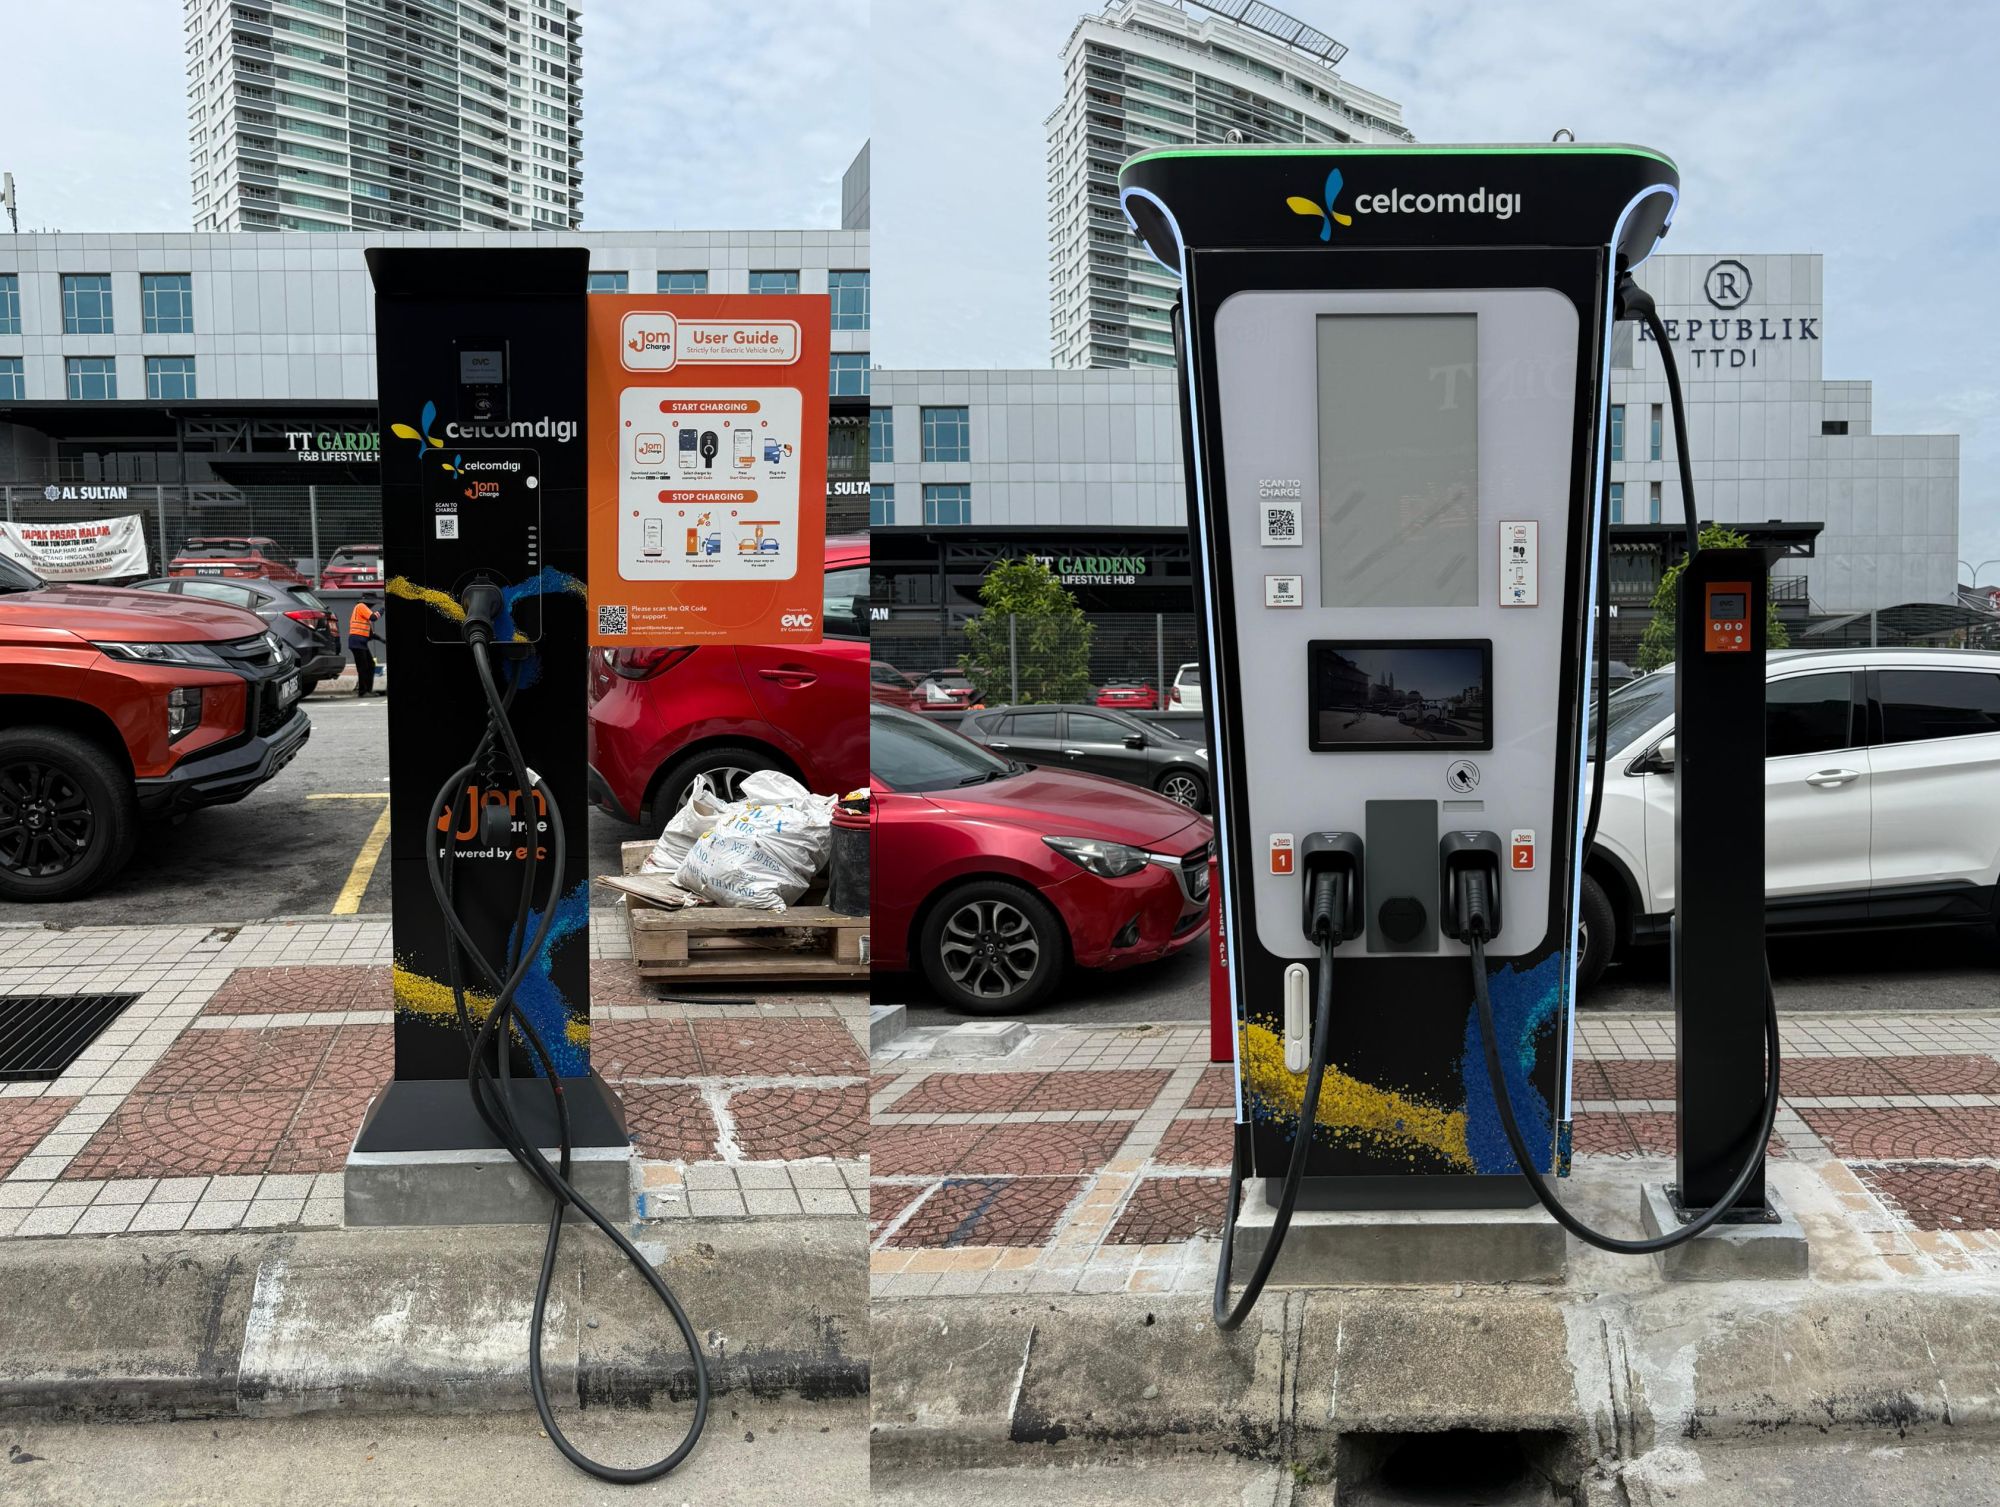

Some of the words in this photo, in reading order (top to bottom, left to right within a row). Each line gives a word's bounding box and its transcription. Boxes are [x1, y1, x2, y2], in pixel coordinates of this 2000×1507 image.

[1354, 187, 1521, 220] celcomdigi
[1716, 272, 1741, 299] R
[1637, 318, 1819, 342] REPUBLIK
[634, 330, 671, 352] Jom
[693, 330, 728, 344] User
[733, 330, 778, 344] Guide
[645, 343, 671, 351] Charge
[686, 346, 709, 354] Strictly
[710, 346, 720, 354] for
[721, 346, 743, 354] Electric
[745, 346, 768, 354] Vehicle
[769, 346, 785, 354] Only
[1691, 349, 1756, 368] TTDI
[672, 403, 698, 411] START
[699, 403, 748, 411] CHARGING
[446, 416, 577, 443] celcomdigi
[285, 432, 313, 451] TT
[317, 432, 380, 451] GARDE
[642, 443, 662, 455] Jom
[298, 452, 319, 462] F&B
[321, 452, 373, 462] LIFESTYLE
[464, 460, 521, 473] celcomdigi
[470, 481, 499, 499] Jom
[834, 482, 871, 495] SULTA
[1259, 479, 1285, 488] SCAN
[1286, 479, 1301, 488] TO
[62, 486, 78, 499] AL
[80, 486, 128, 500] SULTAN
[479, 491, 500, 499] Charge
[672, 493, 695, 501] STOP
[696, 493, 744, 501] CHARGING
[1259, 488, 1301, 497] CHARGE
[21, 530, 49, 540] TAPAK
[49, 528, 77, 539] PASAR
[78, 526, 111, 538] MALAM
[95, 557, 113, 565] ANDA
[1058, 556, 1146, 574] GARDENS
[1062, 575, 1112, 585] LIFESTYLE
[1114, 575, 1136, 585] HUB
[642, 613, 669, 621] support.
[781, 614, 813, 627] evc
[439, 847, 494, 858] Pwered
[496, 847, 512, 861] by
[515, 846, 548, 860] ec
[752, 850, 764, 862] 20
[1518, 851, 1528, 864] 2
[1278, 854, 1286, 867] 1
